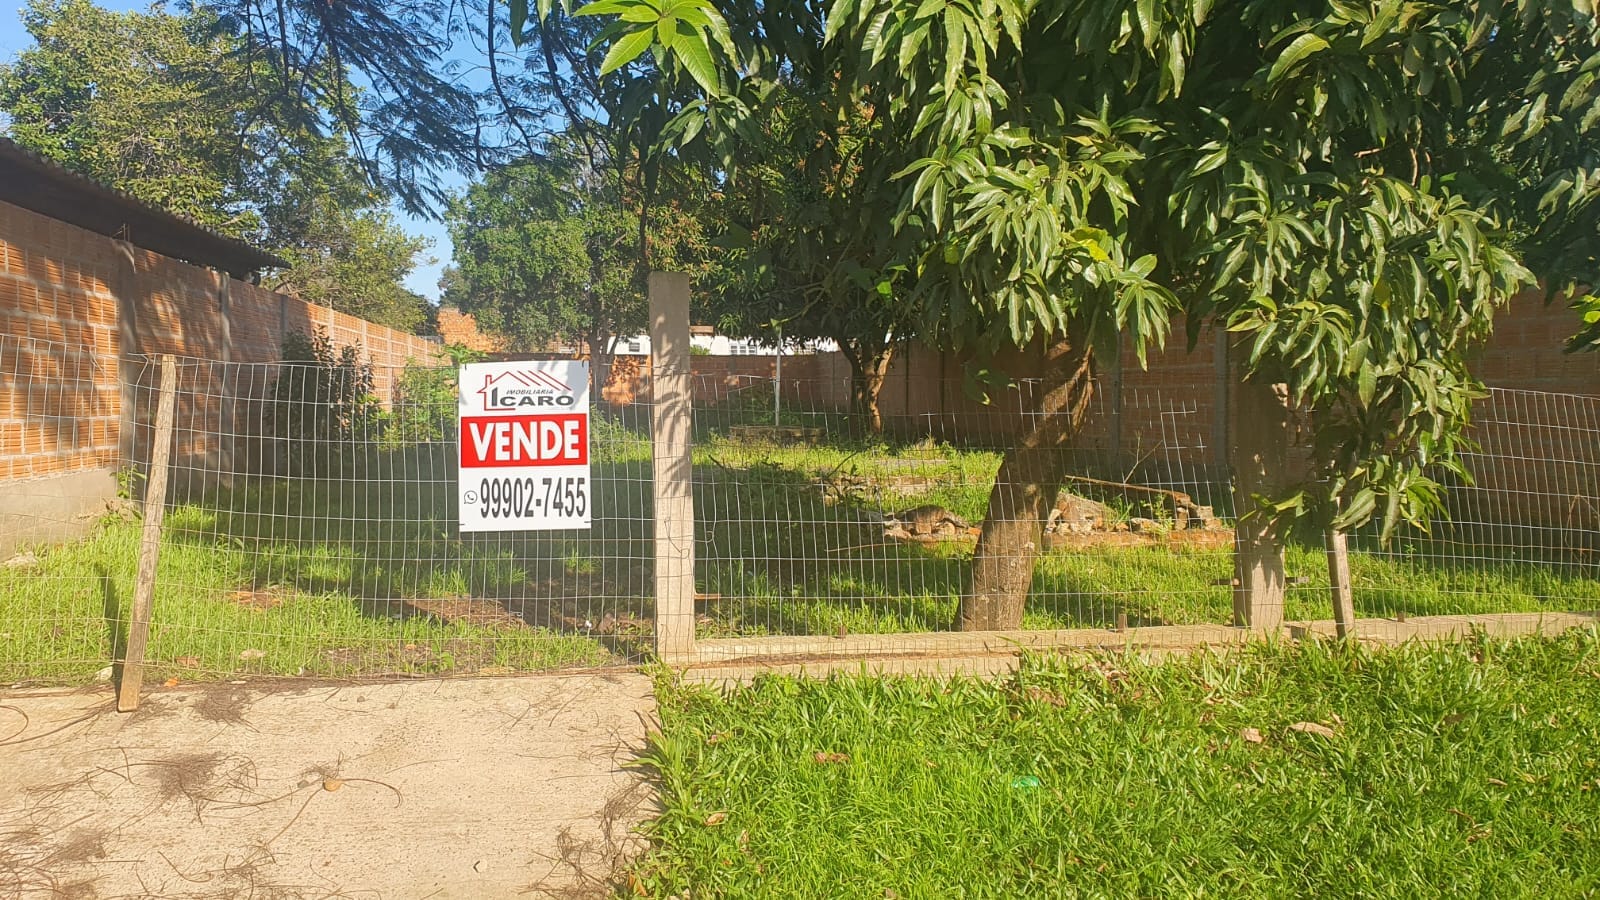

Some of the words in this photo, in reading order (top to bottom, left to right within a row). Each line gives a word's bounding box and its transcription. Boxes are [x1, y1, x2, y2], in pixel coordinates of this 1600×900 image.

[491, 387, 574, 407] ICARO
[469, 420, 580, 461] VENDE
[480, 477, 586, 518] 99902-7455
